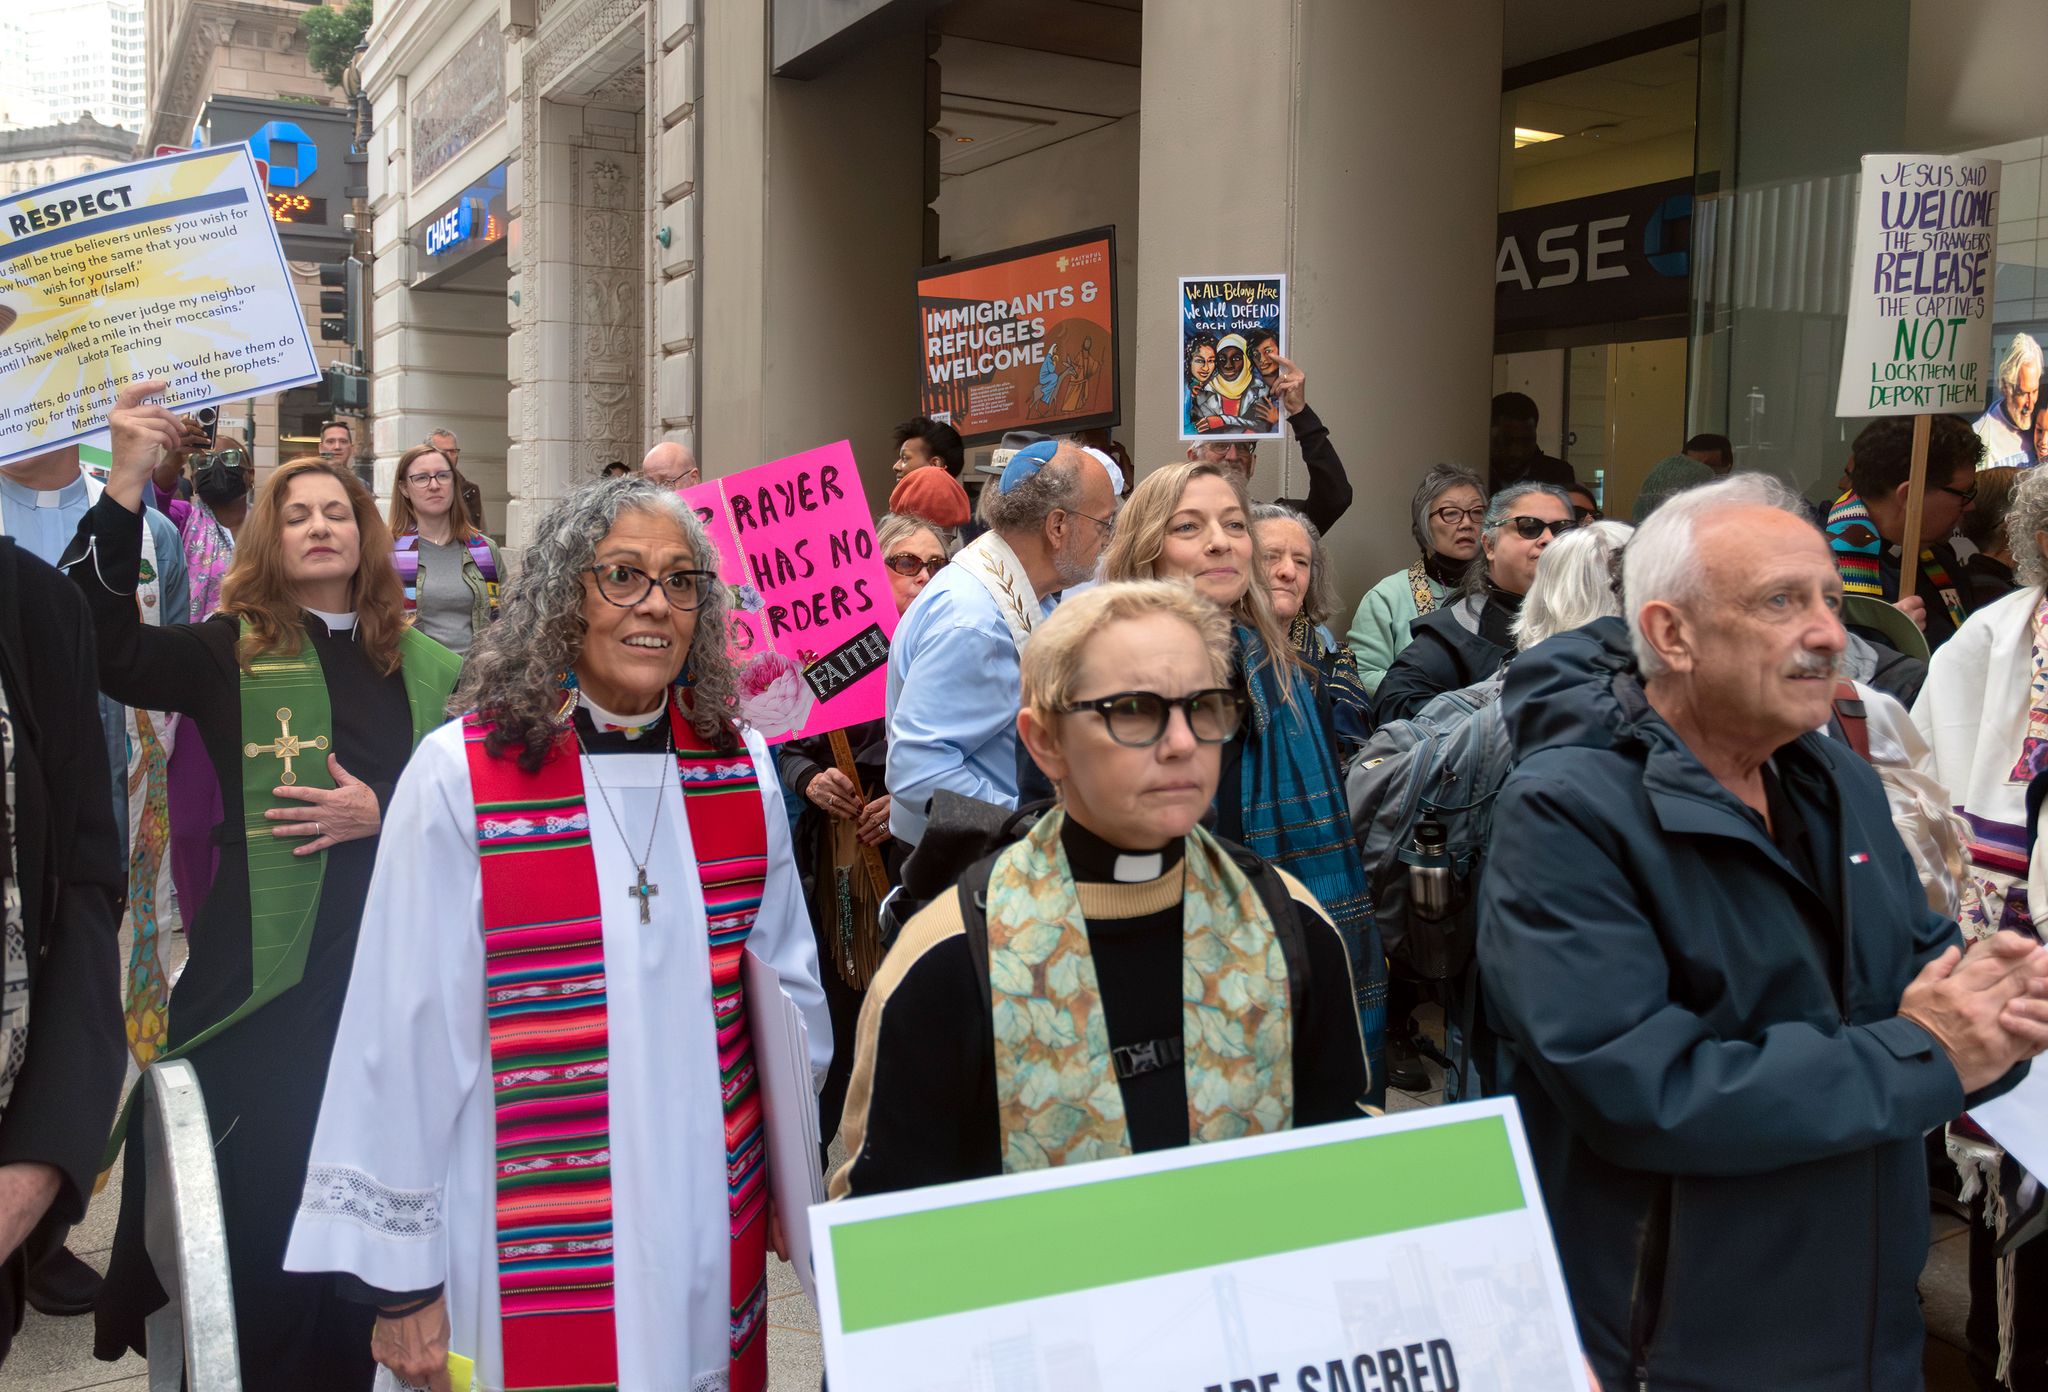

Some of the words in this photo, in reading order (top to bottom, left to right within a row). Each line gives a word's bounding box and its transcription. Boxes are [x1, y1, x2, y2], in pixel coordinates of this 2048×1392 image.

[1881, 161, 1954, 188] JESUS
[1955, 165, 1987, 188] SAID
[9, 186, 132, 237] RESPECT
[426, 207, 460, 255] CHASE
[1881, 189, 1999, 231] WELCOME
[9, 258, 33, 275] shall
[33, 255, 48, 266] be
[50, 249, 73, 261] true
[75, 234, 130, 254] believers
[133, 224, 172, 240] unless
[174, 220, 198, 234] you
[200, 211, 228, 225] wish
[231, 208, 248, 220] for
[15, 271, 52, 288] human
[53, 261, 86, 277] being
[88, 254, 107, 266] the
[111, 248, 143, 262] same
[146, 239, 172, 253] that
[174, 235, 197, 249] you
[199, 224, 238, 241] would
[1496, 215, 1631, 290] ASE
[1879, 230, 1917, 253] THE
[43, 281, 67, 296] wish
[69, 277, 85, 287] for
[59, 288, 99, 307] Sunnatt
[101, 277, 140, 296] (Islam)
[1186, 284, 1202, 300] We
[1873, 250, 1989, 297] RELEASE
[14, 336, 46, 354] Spirit,
[45, 329, 69, 344] help
[71, 324, 87, 335] me
[89, 320, 101, 330] to
[103, 309, 137, 325] never
[139, 303, 176, 319] judge
[179, 296, 198, 308] my
[201, 284, 256, 303] neighbor
[927, 285, 1075, 334] IMMIGRANTS
[1081, 280, 1098, 303] &
[1184, 303, 1201, 320] We
[1877, 296, 1911, 317] THE
[1916, 296, 1985, 320] CAPTIVES
[27, 351, 53, 366] have
[54, 337, 90, 357] walked
[93, 337, 100, 345] a
[101, 328, 126, 343] mile
[129, 325, 141, 335] in
[143, 317, 171, 331] their
[77, 350, 109, 365] Lakota
[111, 335, 162, 355] Teaching
[928, 317, 1045, 358] REFUGEES
[1892, 317, 1967, 362] NOT
[14, 399, 55, 416] matters,
[57, 392, 71, 403] do
[73, 387, 95, 399] unto
[98, 375, 128, 391] others
[132, 370, 144, 381] as
[147, 364, 170, 380] you
[173, 353, 210, 370] would
[214, 348, 242, 361] have
[245, 341, 275, 354] them
[279, 336, 295, 347] do
[929, 342, 1045, 384] WELCOME
[0, 423, 23, 436] unto
[25, 417, 48, 431] you,
[49, 410, 64, 421] for
[66, 404, 84, 416] this
[87, 396, 112, 411] sums
[175, 372, 198, 387] and
[201, 369, 221, 380] the
[1869, 385, 1935, 410] DEPORT
[750, 538, 815, 592] HAS
[829, 528, 873, 569] NO
[806, 630, 889, 698] FAITH
